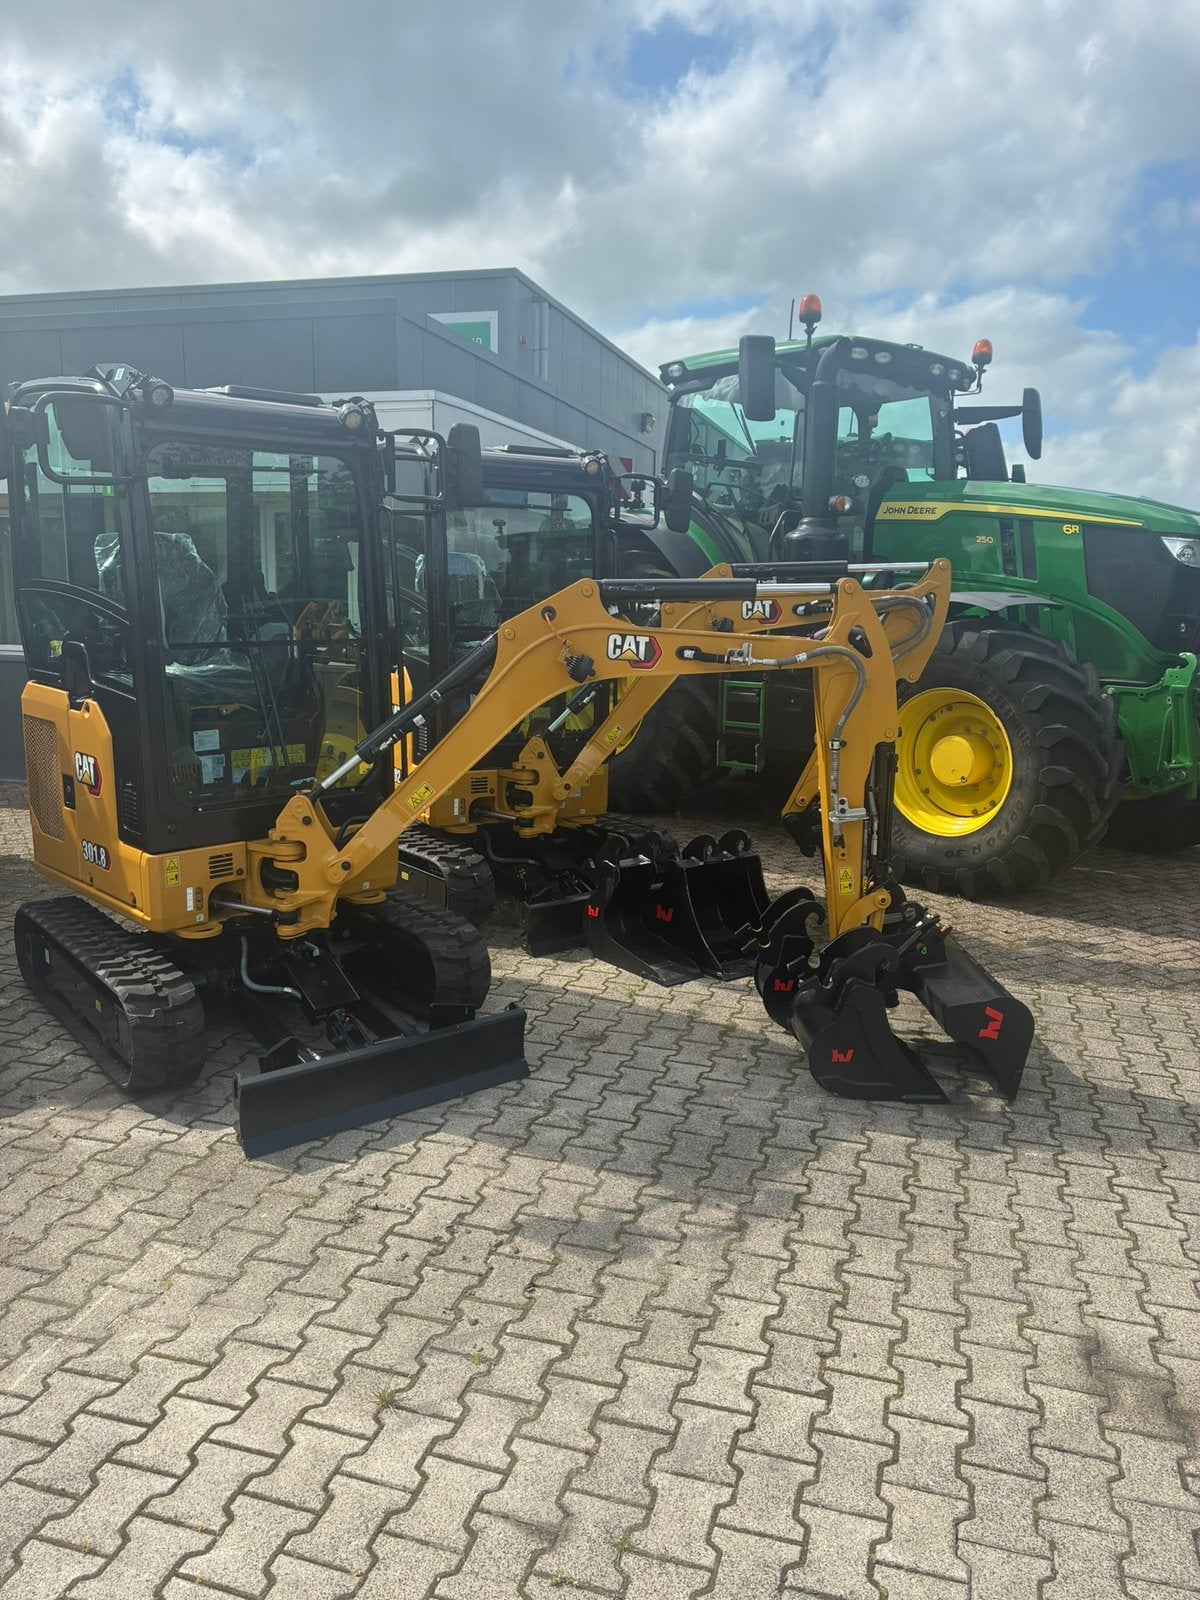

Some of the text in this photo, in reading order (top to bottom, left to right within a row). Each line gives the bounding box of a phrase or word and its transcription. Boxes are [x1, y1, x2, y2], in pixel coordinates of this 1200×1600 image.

[882, 505, 938, 515] JOHN DEERE
[1062, 524, 1080, 535] 6R
[975, 536, 994, 544] 250
[741, 600, 772, 620] CAT
[608, 633, 650, 662] CAT
[75, 751, 95, 786] CAT
[81, 840, 106, 868] 301.8
